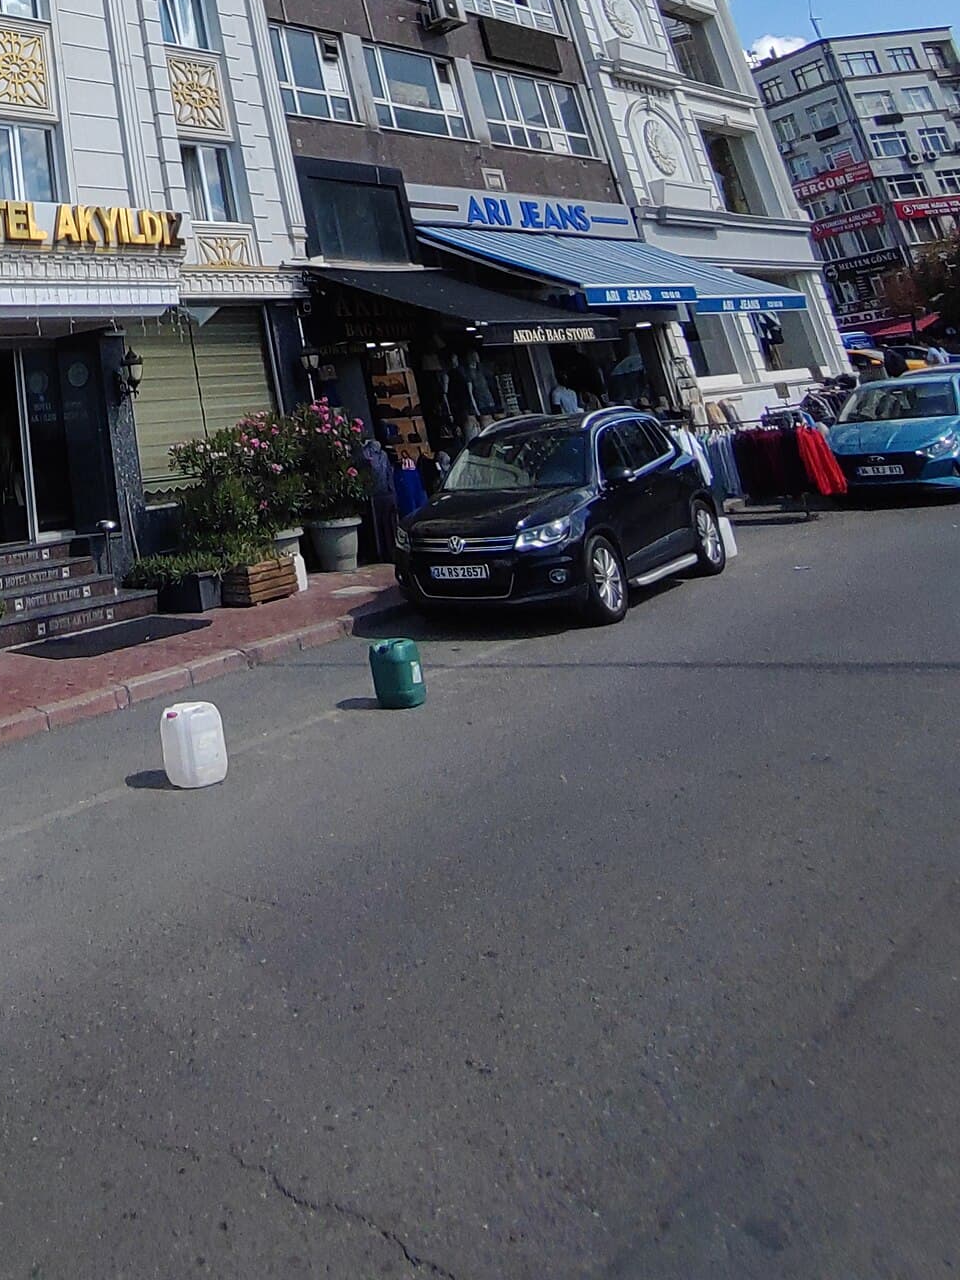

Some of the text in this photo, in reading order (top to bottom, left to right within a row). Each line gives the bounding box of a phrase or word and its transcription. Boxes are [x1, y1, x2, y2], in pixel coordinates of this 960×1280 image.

[467, 195, 591, 232] ARI JEANS
[56, 203, 186, 247] AKYILDIZ
[605, 289, 620, 302] ARI
[626, 289, 653, 301] JEANS
[545, 328, 566, 342] BAG
[565, 327, 596, 341] STORE
[447, 567, 459, 577] RS
[460, 566, 483, 577] 2657
[5, 575, 28, 587] HOTEL
